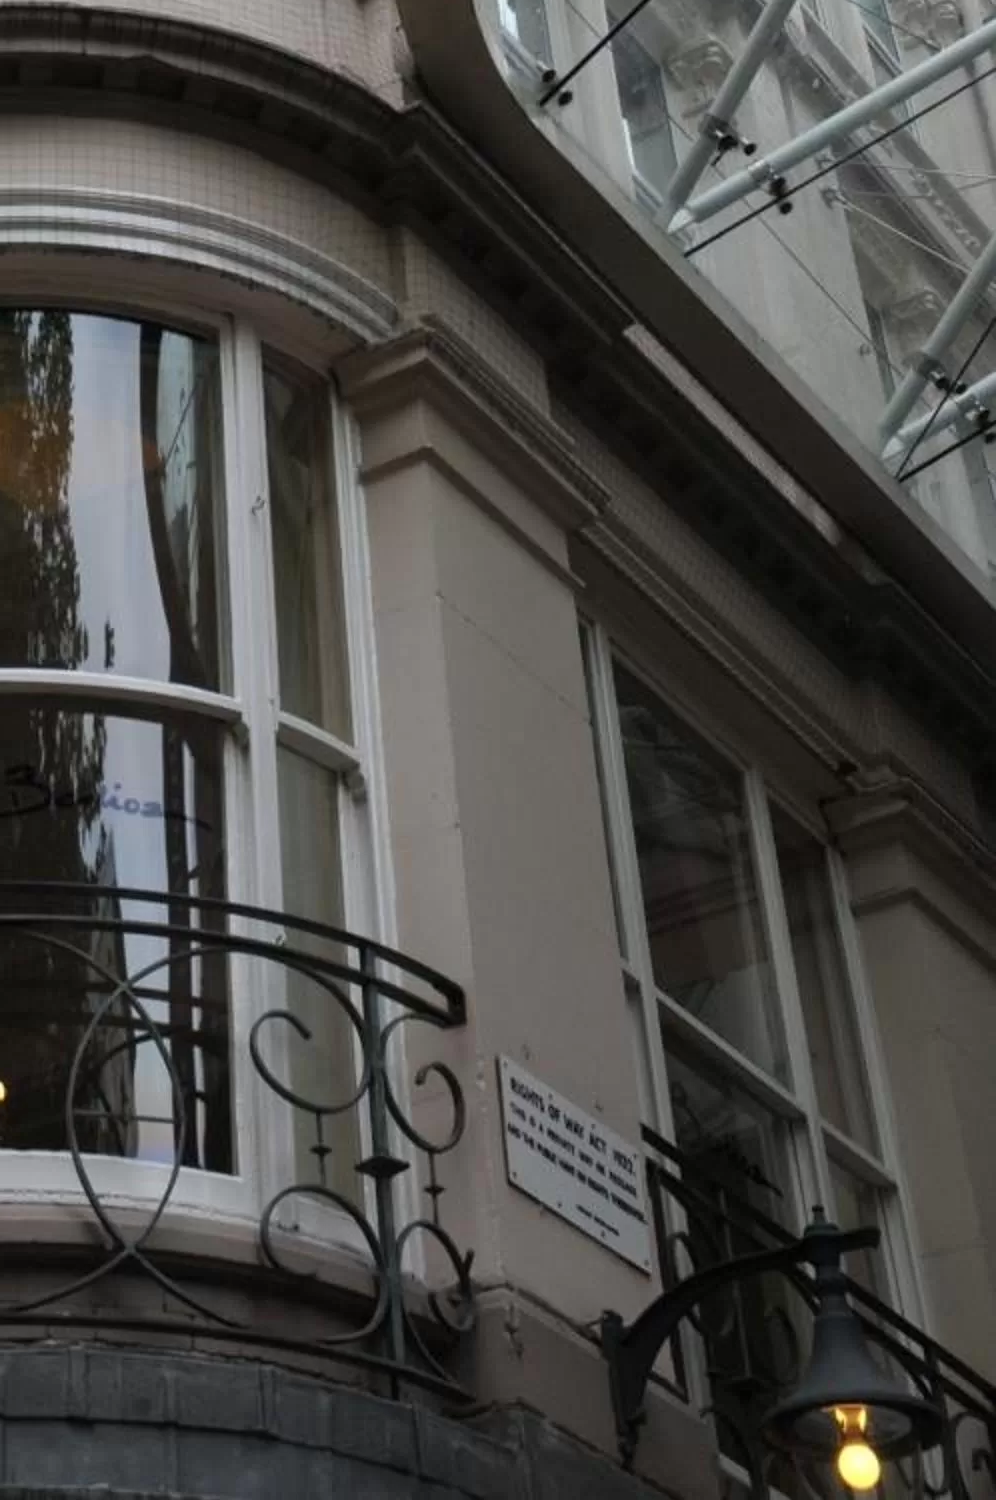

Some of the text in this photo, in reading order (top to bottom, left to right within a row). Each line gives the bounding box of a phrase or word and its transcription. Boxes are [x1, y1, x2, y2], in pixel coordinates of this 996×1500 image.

[510, 1076, 545, 1113] RIGHTS
[548, 1104, 561, 1123] OF
[563, 1113, 584, 1139] WAY
[589, 1131, 607, 1155] ACT
